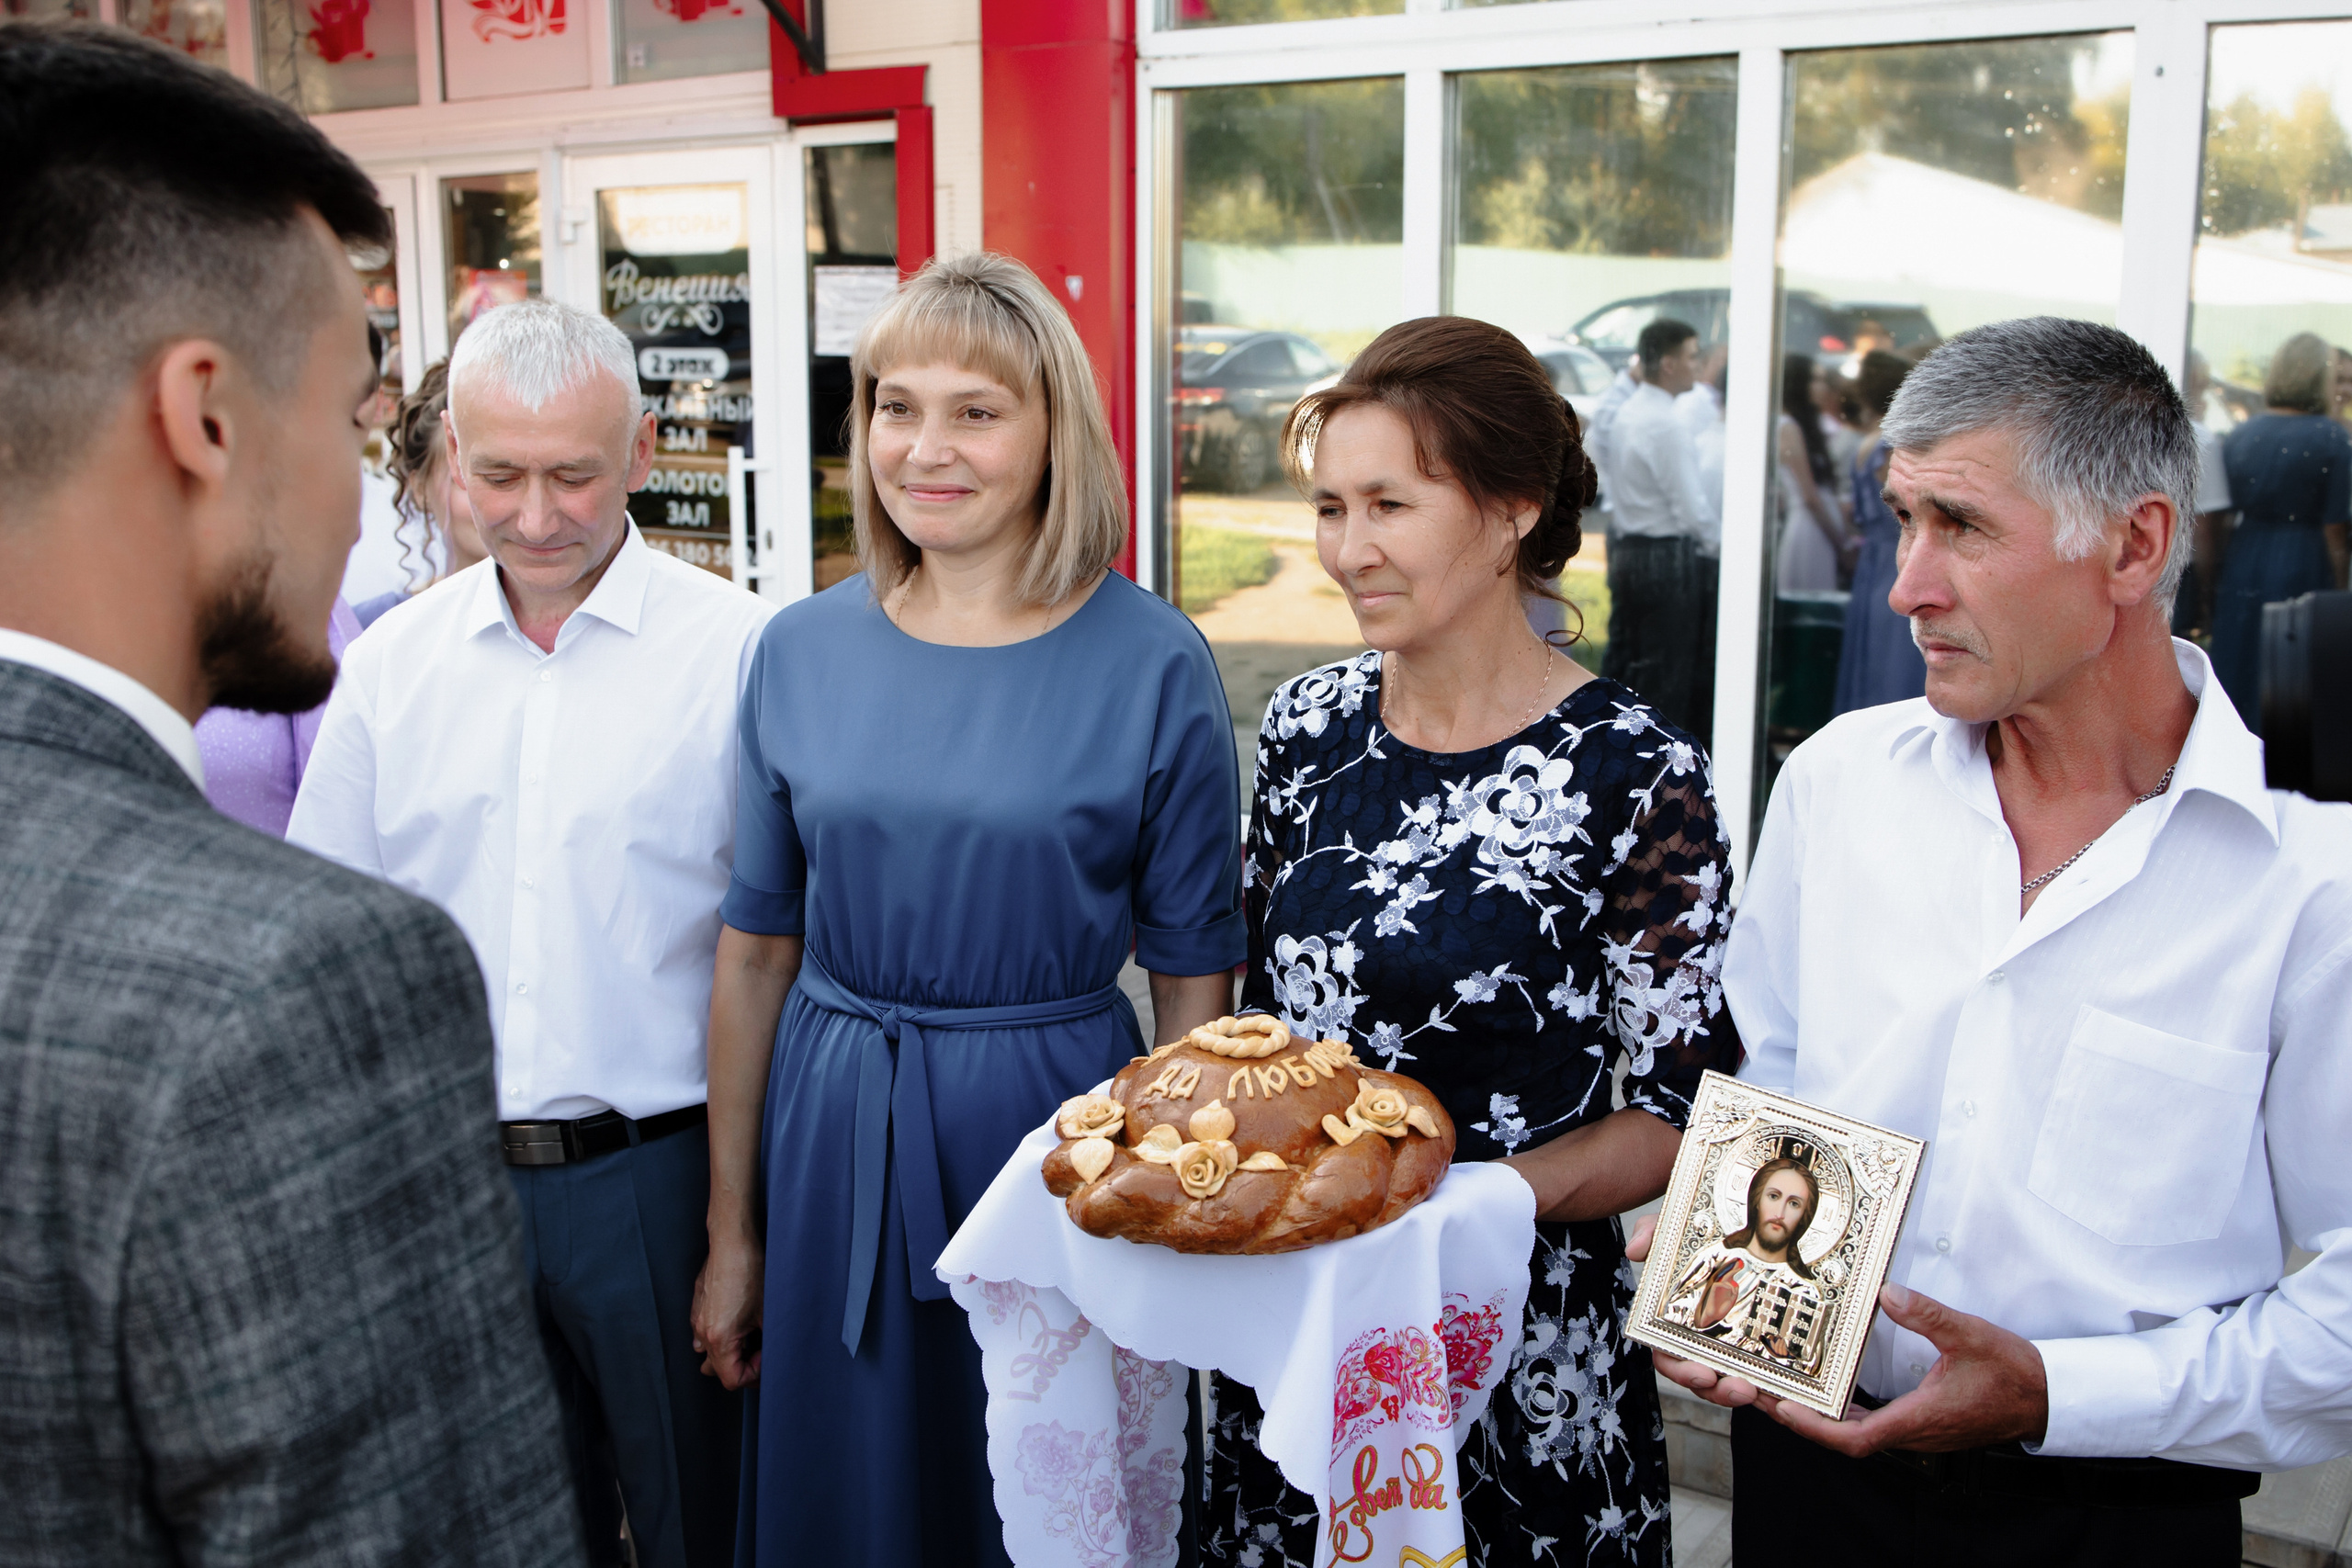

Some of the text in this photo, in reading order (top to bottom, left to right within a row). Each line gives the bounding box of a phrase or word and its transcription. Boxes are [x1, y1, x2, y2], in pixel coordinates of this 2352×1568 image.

[651, 353, 662, 374] 2
[664, 426, 707, 451] ЗАЛ
[640, 469, 729, 497] ОЛОТО
[666, 501, 710, 526] ЗАЛ
[1145, 1065, 1202, 1100] ДА
[1402, 1443, 1448, 1510] да
